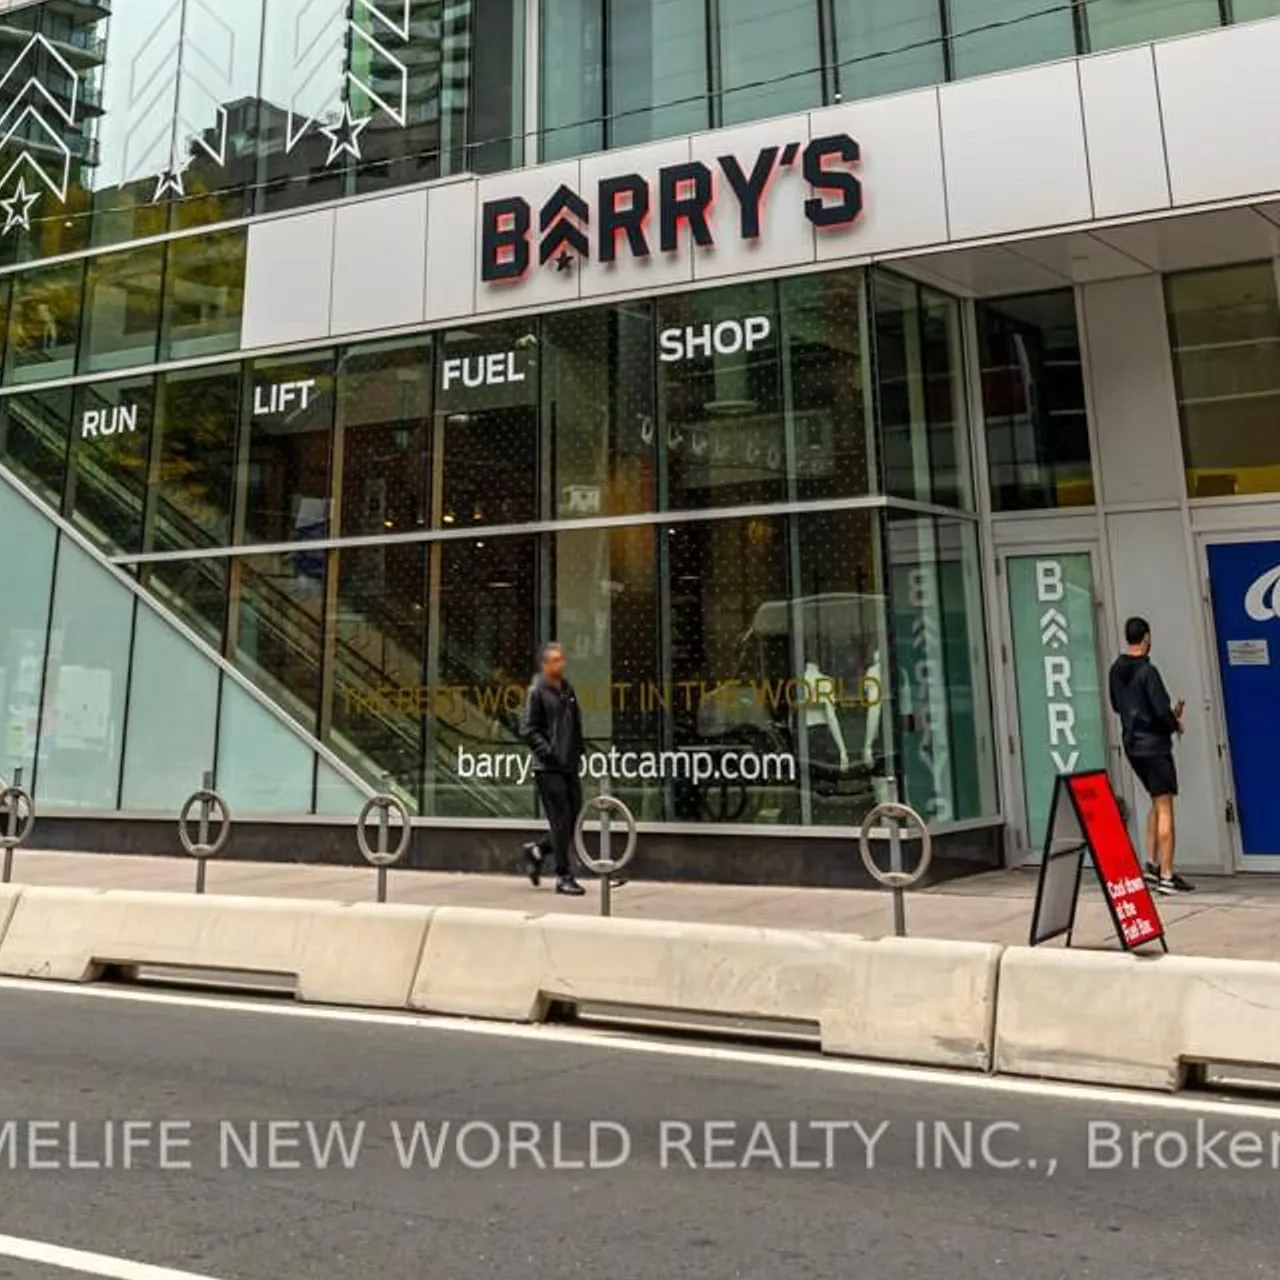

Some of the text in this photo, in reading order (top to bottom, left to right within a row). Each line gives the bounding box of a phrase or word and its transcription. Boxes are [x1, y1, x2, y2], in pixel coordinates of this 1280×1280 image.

[481, 132, 866, 283] BARRY'S
[658, 316, 772, 362] SHOP
[441, 351, 525, 390] FUEL
[253, 379, 316, 415] LIFT
[82, 405, 138, 438] RUN
[474, 678, 636, 714] WOUT
[639, 679, 669, 712] IN
[674, 678, 742, 712] THE
[750, 675, 883, 709] WORLD
[457, 745, 796, 785] barryotcamp.com
